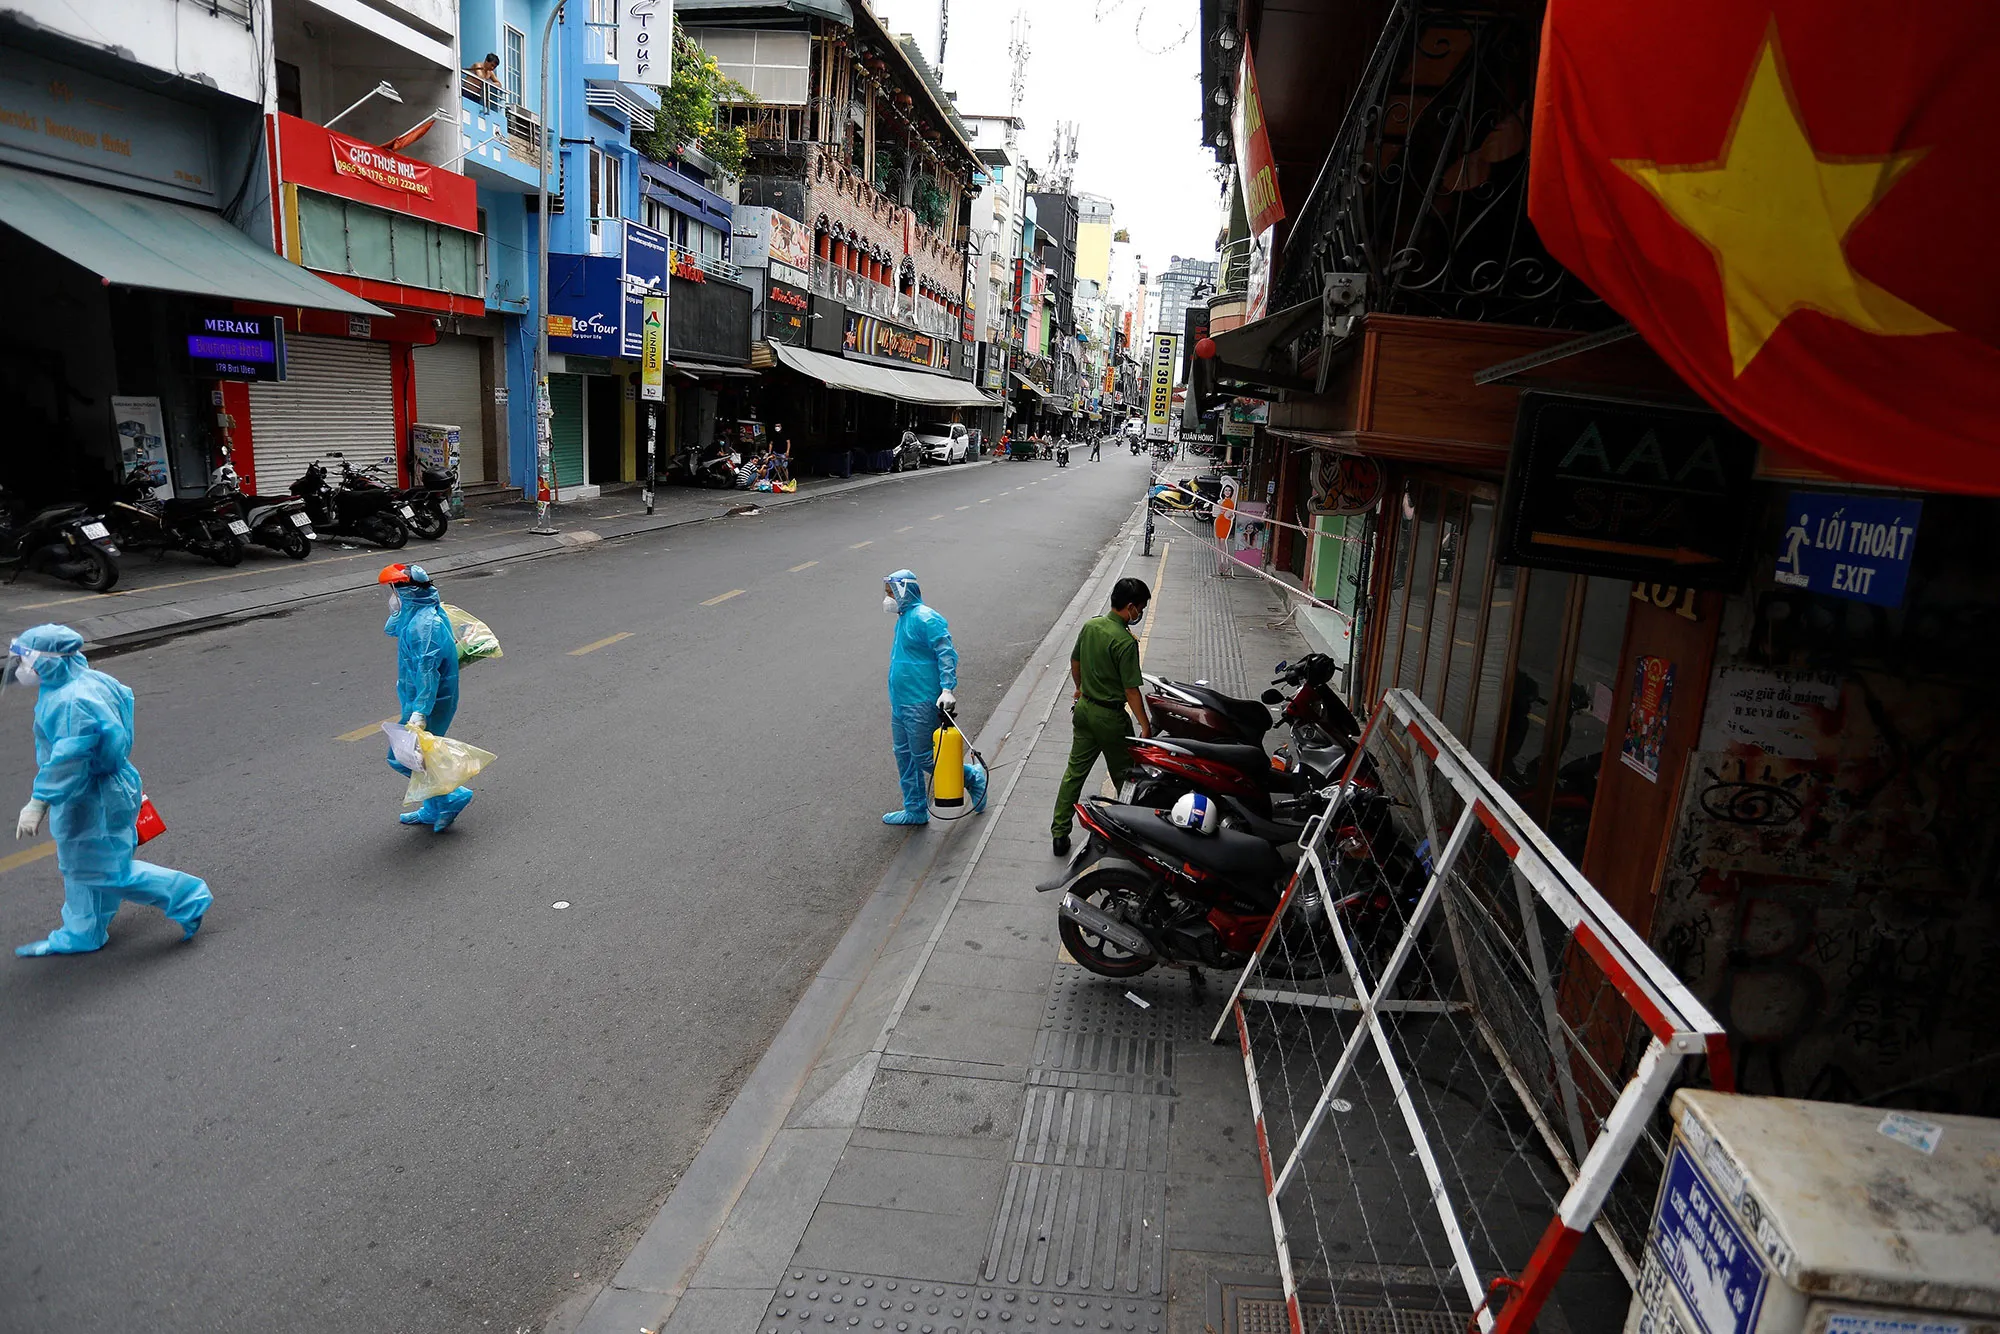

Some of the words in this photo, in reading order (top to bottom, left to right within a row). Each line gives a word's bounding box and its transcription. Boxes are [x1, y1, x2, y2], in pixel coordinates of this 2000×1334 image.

[337, 160, 356, 172] 0966
[350, 147, 371, 165] CHO
[372, 154, 397, 174] THUÊ
[397, 162, 416, 179] NHÀ
[204, 319, 260, 334] MERAKI
[591, 317, 618, 334] Tour
[239, 342, 263, 357] Hotel
[649, 330, 657, 369] VINAMA
[1158, 338, 1171, 367] 0911
[216, 363, 226, 372] 178
[1157, 369, 1169, 385] 39
[1153, 387, 1167, 418] 5555
[1558, 420, 1727, 487] AAA
[1815, 507, 1847, 551] LỐI
[1848, 516, 1913, 561] THOÁT
[1831, 563, 1876, 595] EXIT
